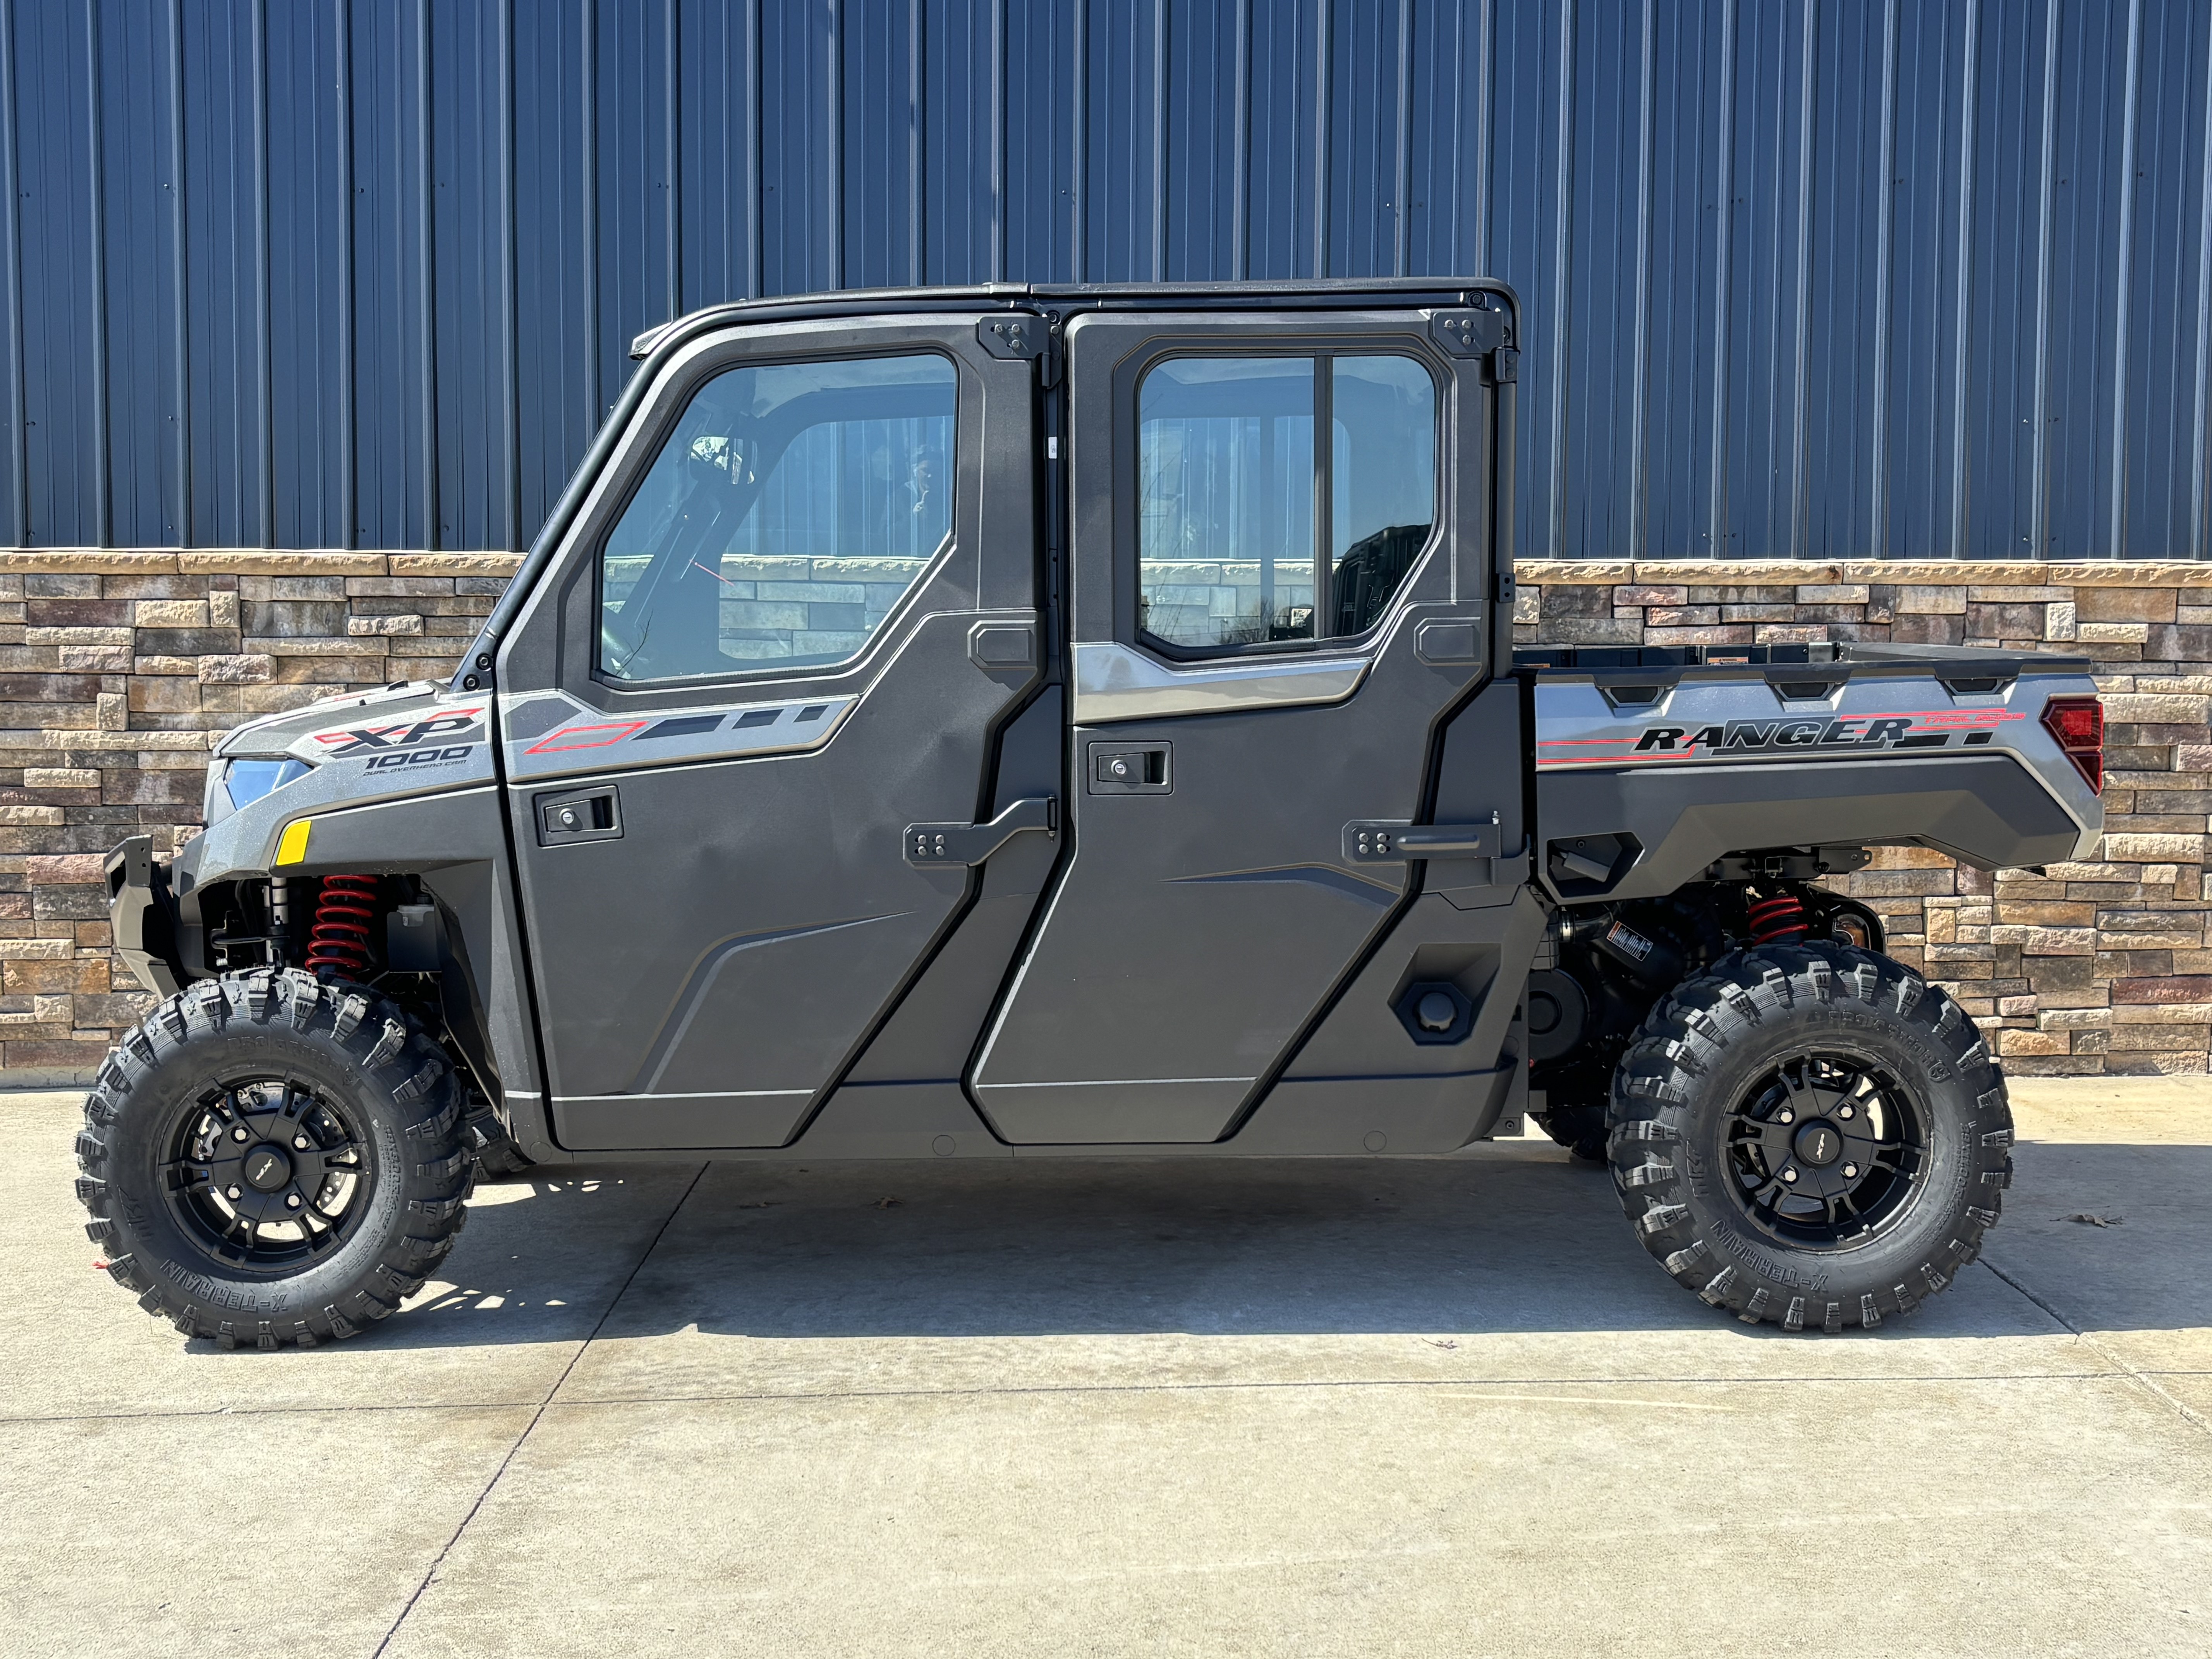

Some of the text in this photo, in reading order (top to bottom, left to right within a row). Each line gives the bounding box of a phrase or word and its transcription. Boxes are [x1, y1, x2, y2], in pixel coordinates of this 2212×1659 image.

[327, 716, 476, 754] XP
[1634, 718, 1913, 750] RANGER
[365, 745, 473, 769] 1000
[1710, 1218, 1829, 1293] X-TERRAIN
[160, 1259, 289, 1312] X-TERRAIN
